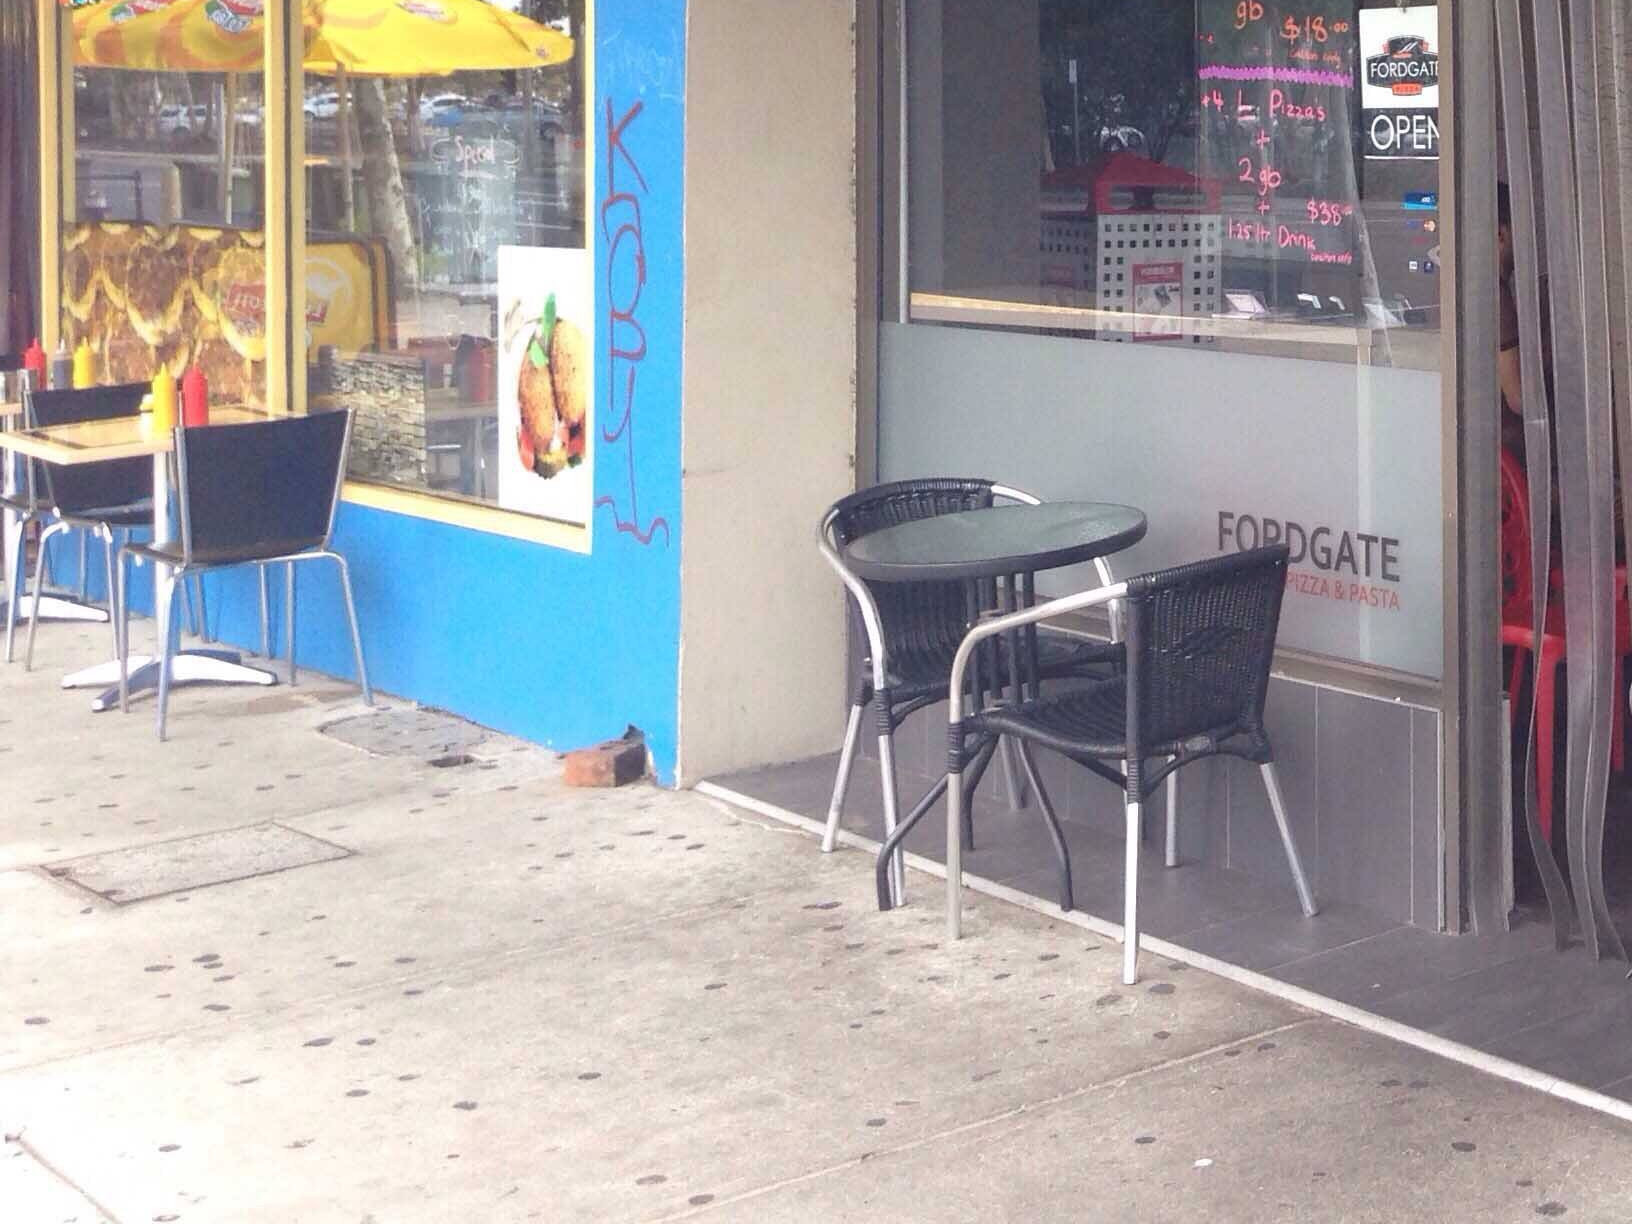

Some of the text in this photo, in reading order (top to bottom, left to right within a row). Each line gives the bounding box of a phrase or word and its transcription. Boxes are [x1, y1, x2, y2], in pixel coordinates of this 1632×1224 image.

[1370, 114, 1440, 151] OPEN
[1217, 510, 1401, 582] FORDGATE
[1286, 568, 1402, 610] PIZZA & PASTA
